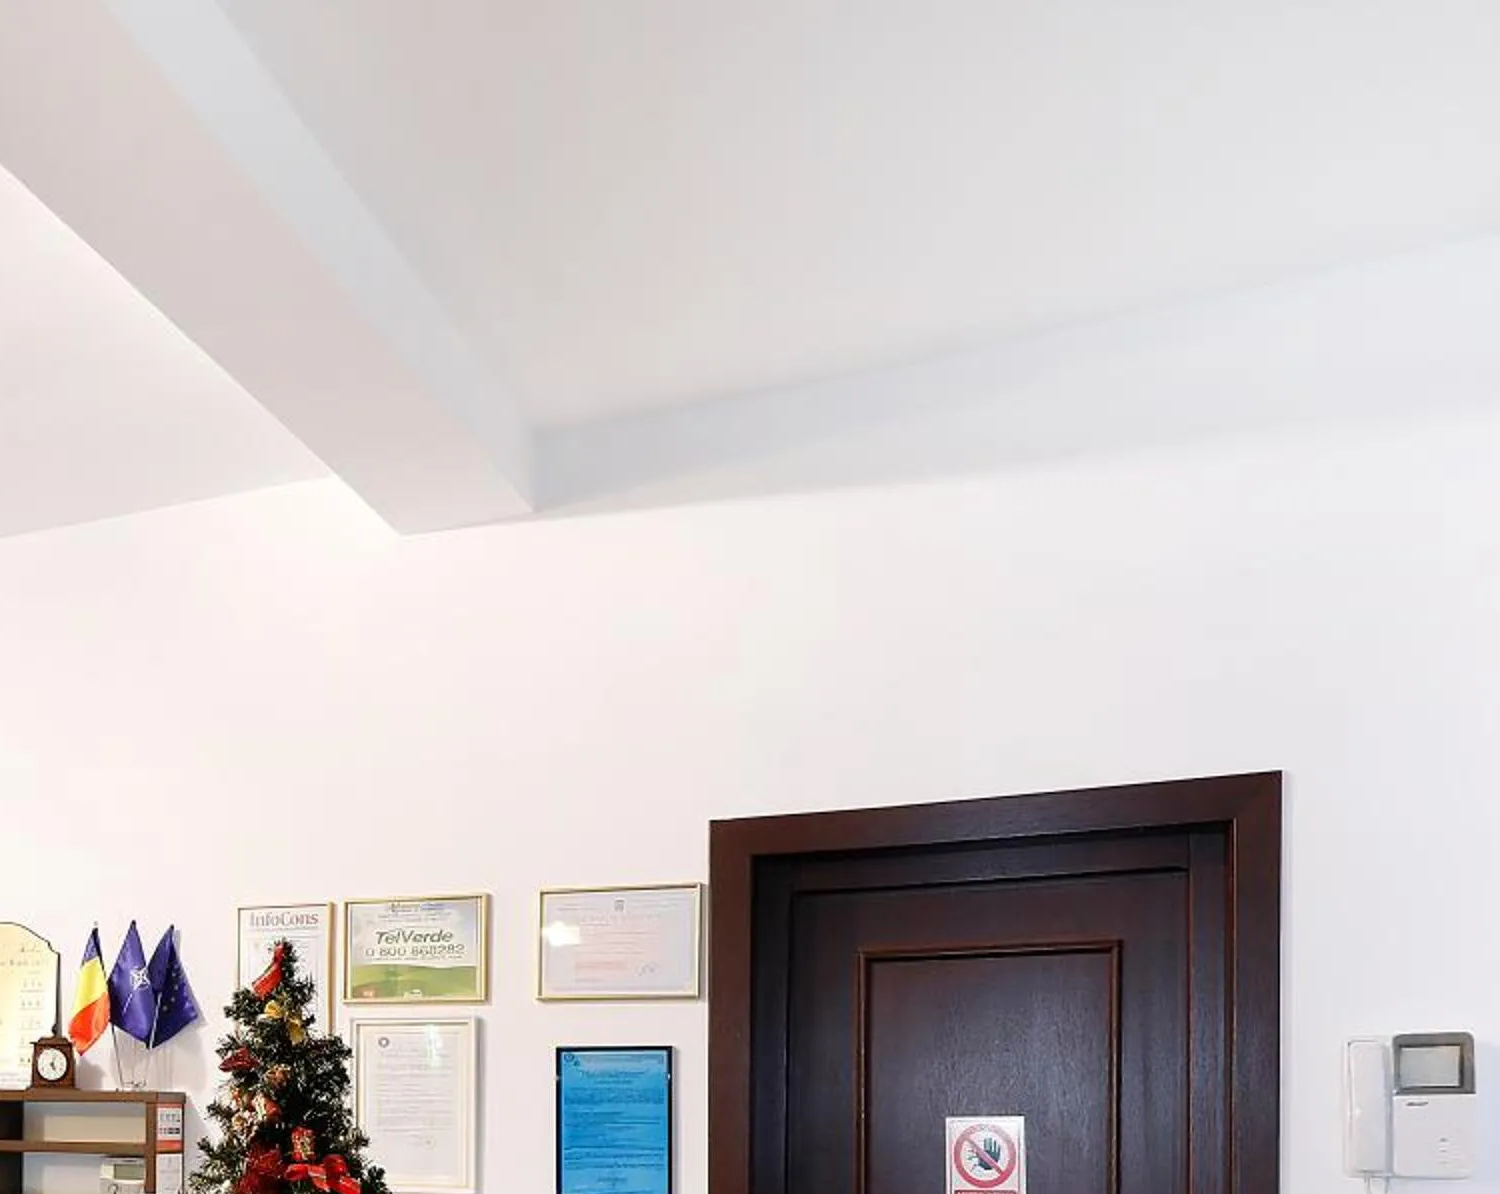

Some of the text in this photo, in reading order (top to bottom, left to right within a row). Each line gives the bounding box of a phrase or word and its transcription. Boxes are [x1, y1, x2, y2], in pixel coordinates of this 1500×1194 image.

[250, 911, 319, 927] InfoCons
[376, 929, 453, 945] TelVerde
[380, 946, 407, 957] 800
